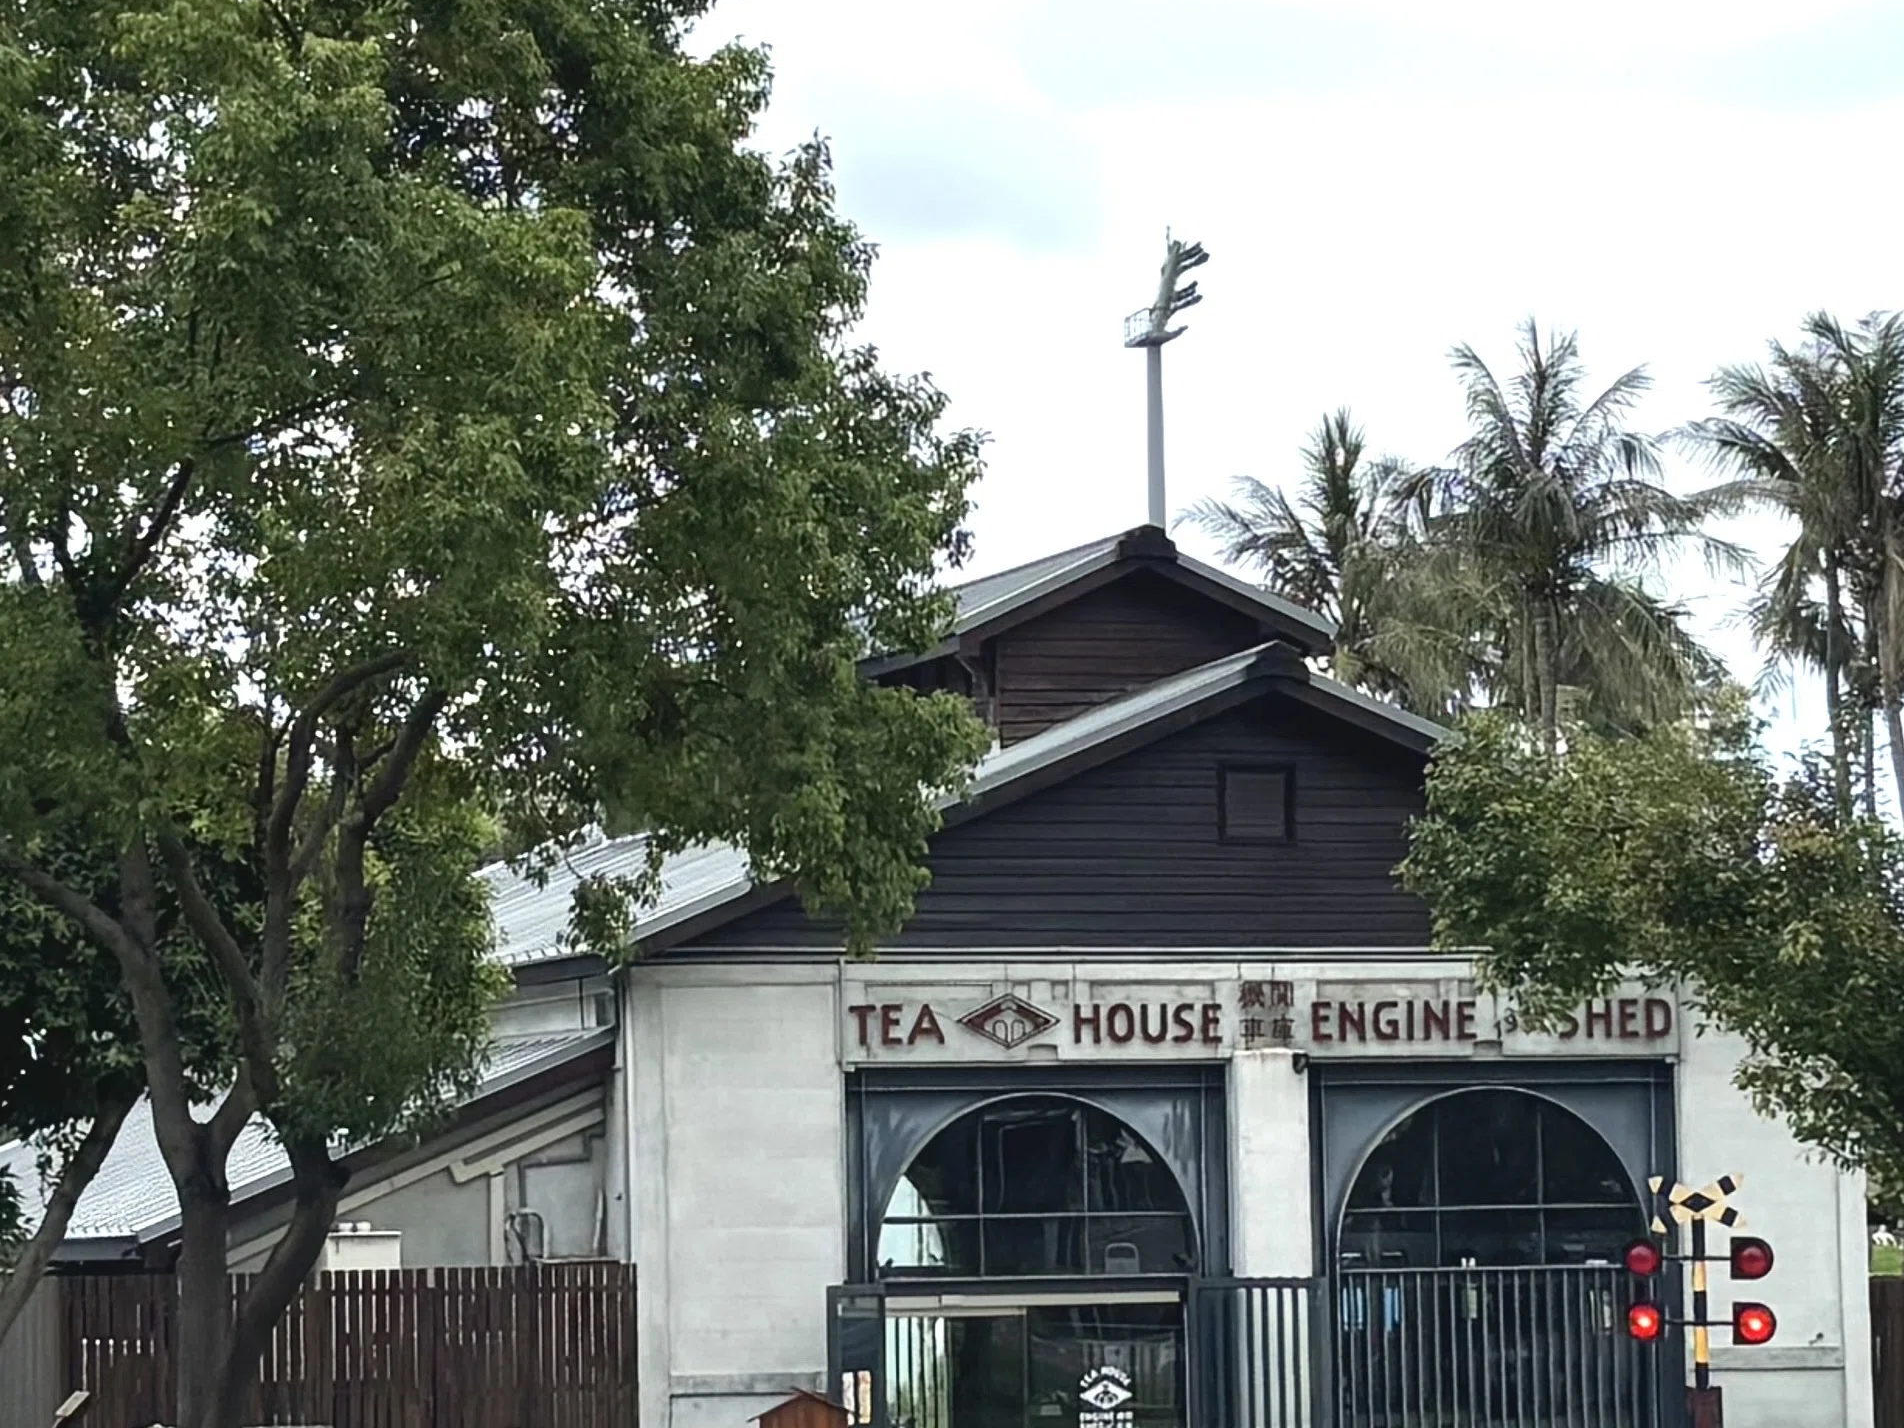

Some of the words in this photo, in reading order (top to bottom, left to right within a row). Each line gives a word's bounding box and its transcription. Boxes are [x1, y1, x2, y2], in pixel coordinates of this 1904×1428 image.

[848, 1003, 946, 1046] TEA
[1073, 1003, 1223, 1044] HOUSE
[1311, 999, 1478, 1043] ENGINE
